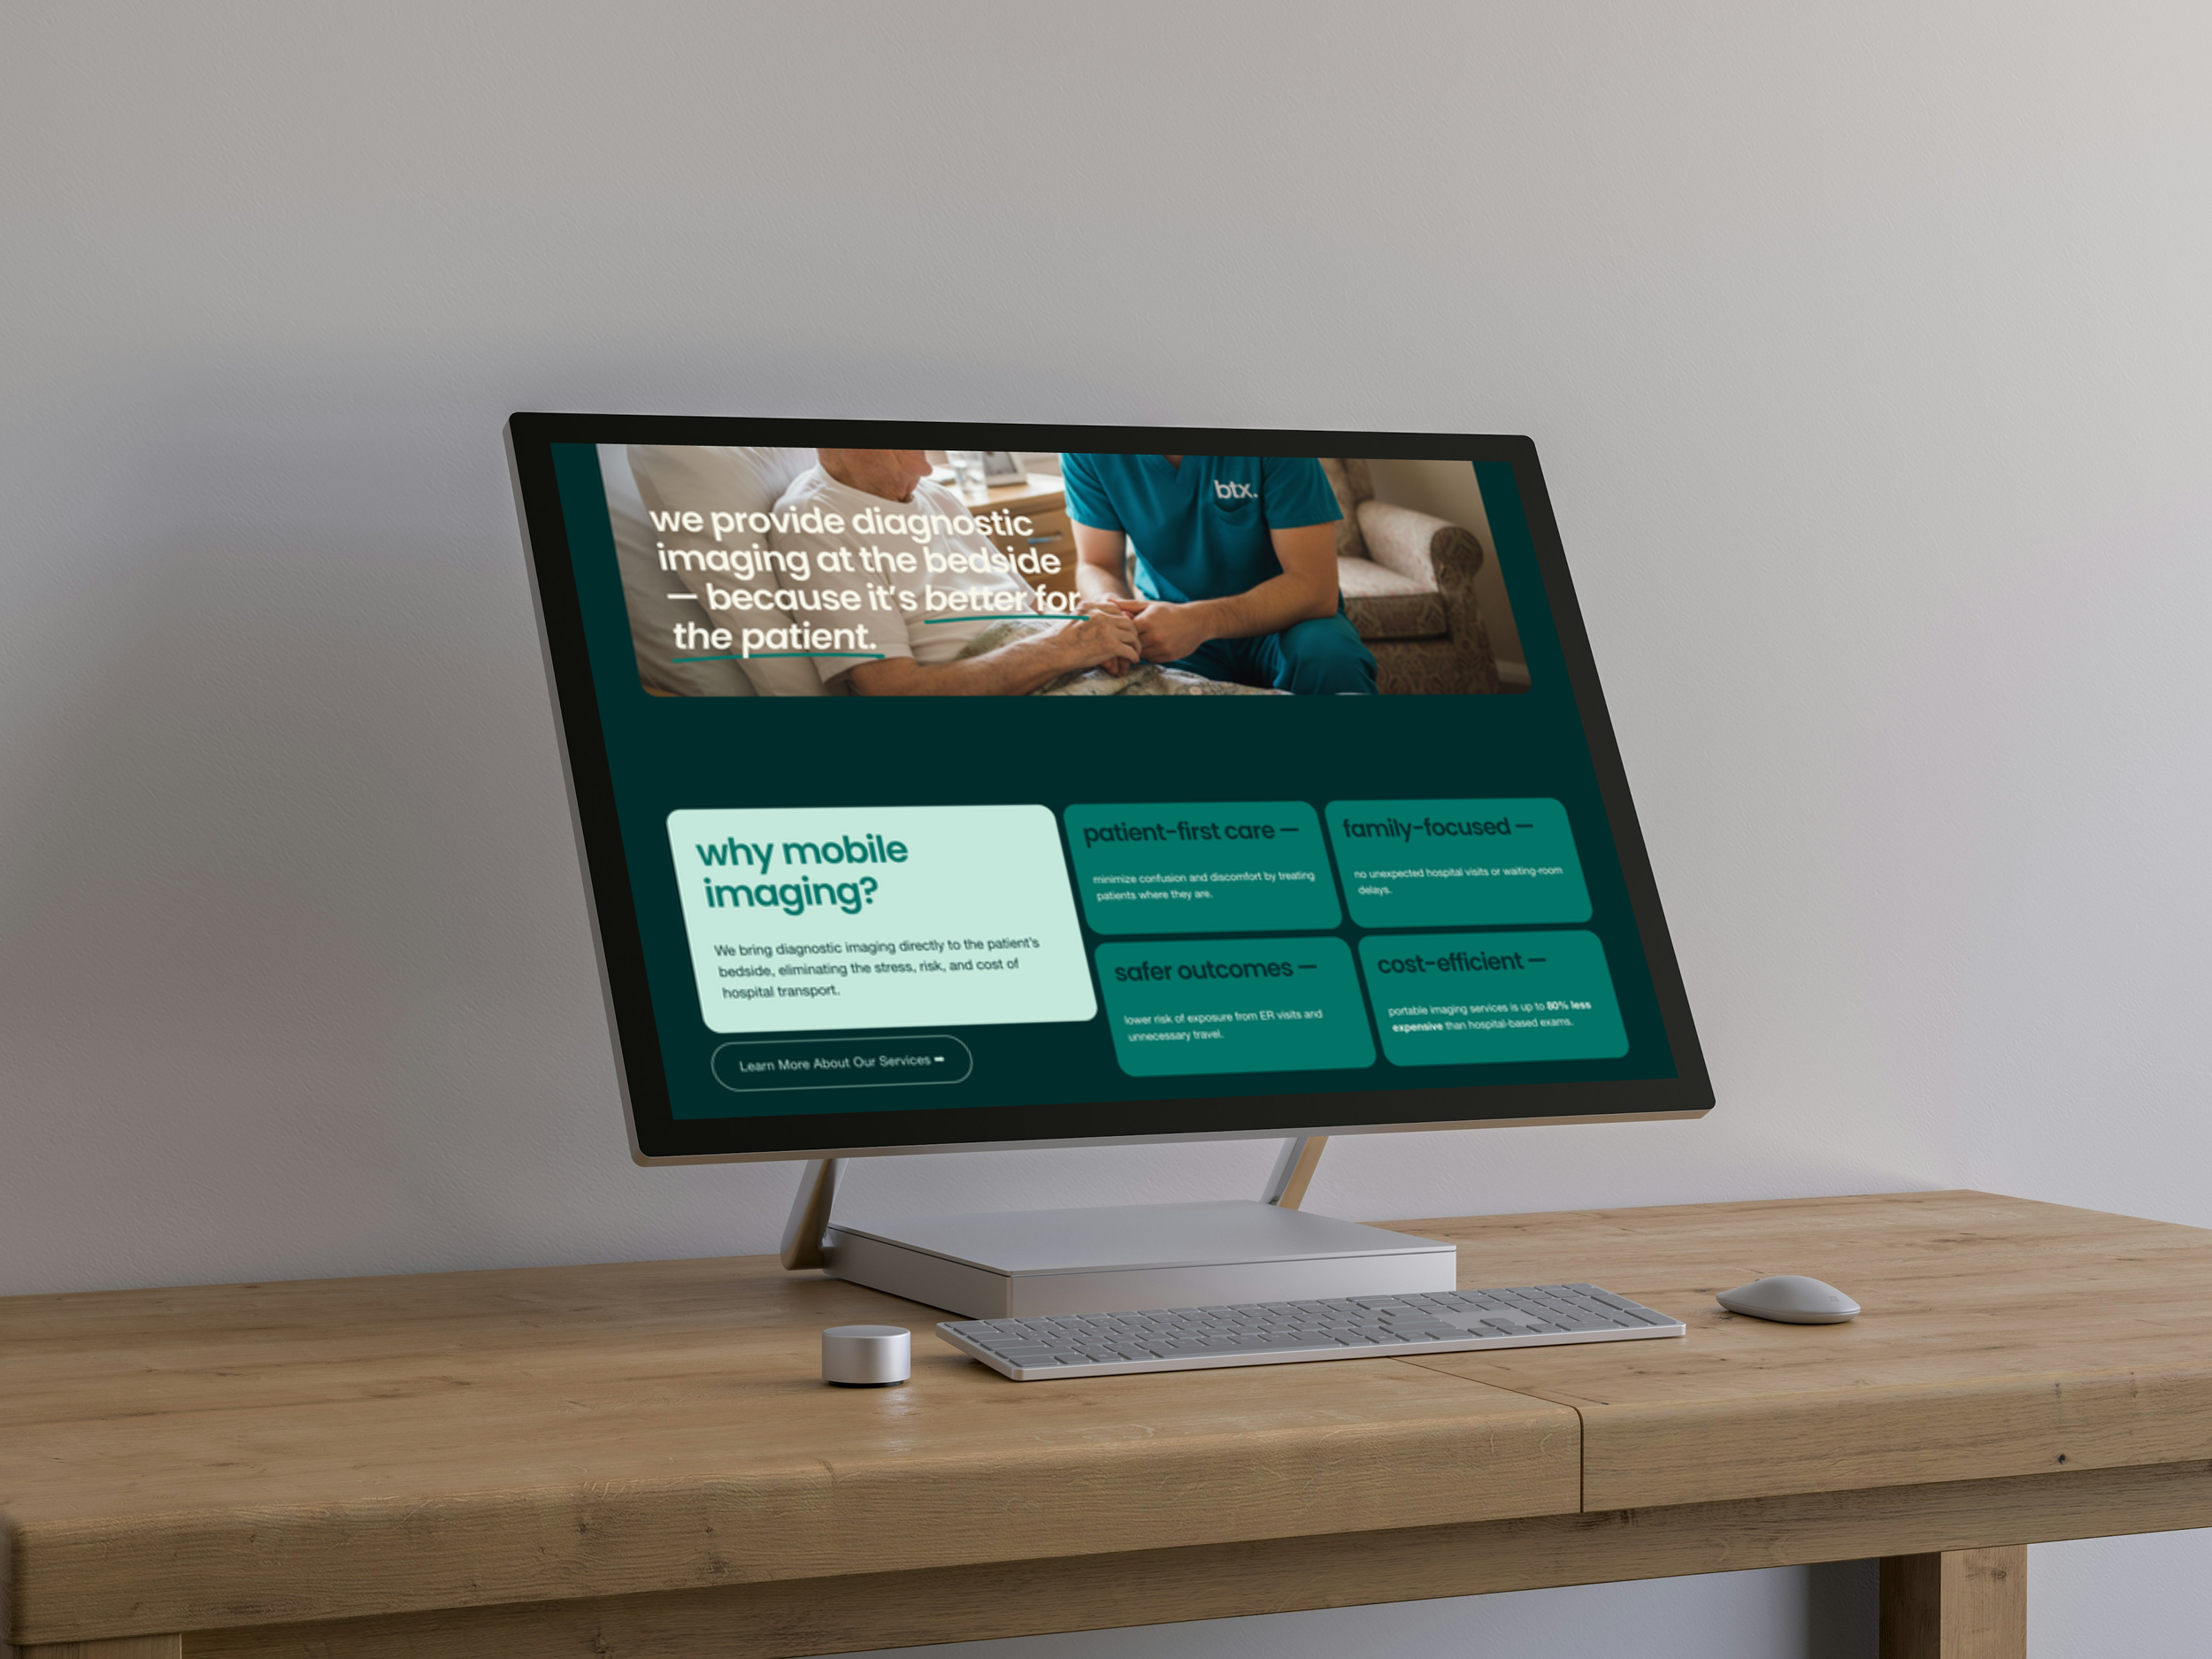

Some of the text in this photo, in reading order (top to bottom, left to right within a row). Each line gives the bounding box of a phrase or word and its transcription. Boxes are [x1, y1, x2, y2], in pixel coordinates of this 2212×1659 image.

[1213, 480, 1258, 499] btx.
[649, 506, 1033, 543] we provide diagnostic
[657, 543, 1061, 580] imaging at the bedside
[706, 584, 862, 611] because
[869, 585, 917, 611] it’s
[925, 585, 1027, 611] better
[1035, 584, 1081, 611] for
[673, 622, 877, 658] the patient.
[1083, 821, 1221, 848] patient-first
[1225, 825, 1275, 840] care
[1342, 818, 1511, 842] family-focused
[695, 833, 909, 874] why mobile
[1093, 871, 1316, 884] minimize confusion and discomfort by treating
[1354, 870, 1367, 879] no
[1369, 868, 1425, 879] unexpected
[1425, 868, 1463, 879] hospital
[1464, 867, 1489, 876] visits
[1502, 866, 1563, 877] waiting-room
[703, 876, 879, 916] imaging?
[1096, 889, 1213, 902] patients where they are.
[1357, 886, 1393, 896] delays.
[714, 936, 1041, 958] We bring diagnostic imaging directly to the patient's
[718, 958, 1019, 979] bedside, eliminating the stress, risk, and cost of
[1115, 961, 1172, 982] safer
[1178, 961, 1294, 980] outcomes
[1378, 951, 1525, 973] cost-efficient
[722, 985, 841, 1000] hospital transport.
[1124, 1010, 1323, 1025] lower risk of exposure from ER visits and
[1387, 1005, 1428, 1018] portable
[1430, 1005, 1468, 1015] imaging
[1470, 1003, 1509, 1013] services
[1510, 1002, 1518, 1011] is
[1520, 1002, 1532, 1012] up
[1571, 1000, 1592, 1010] less
[1128, 1029, 1224, 1042] unnecessary travel.
[1393, 1018, 1574, 1033] expensive than hospital-based exams.
[739, 1055, 931, 1072] Learn More About Our Services
